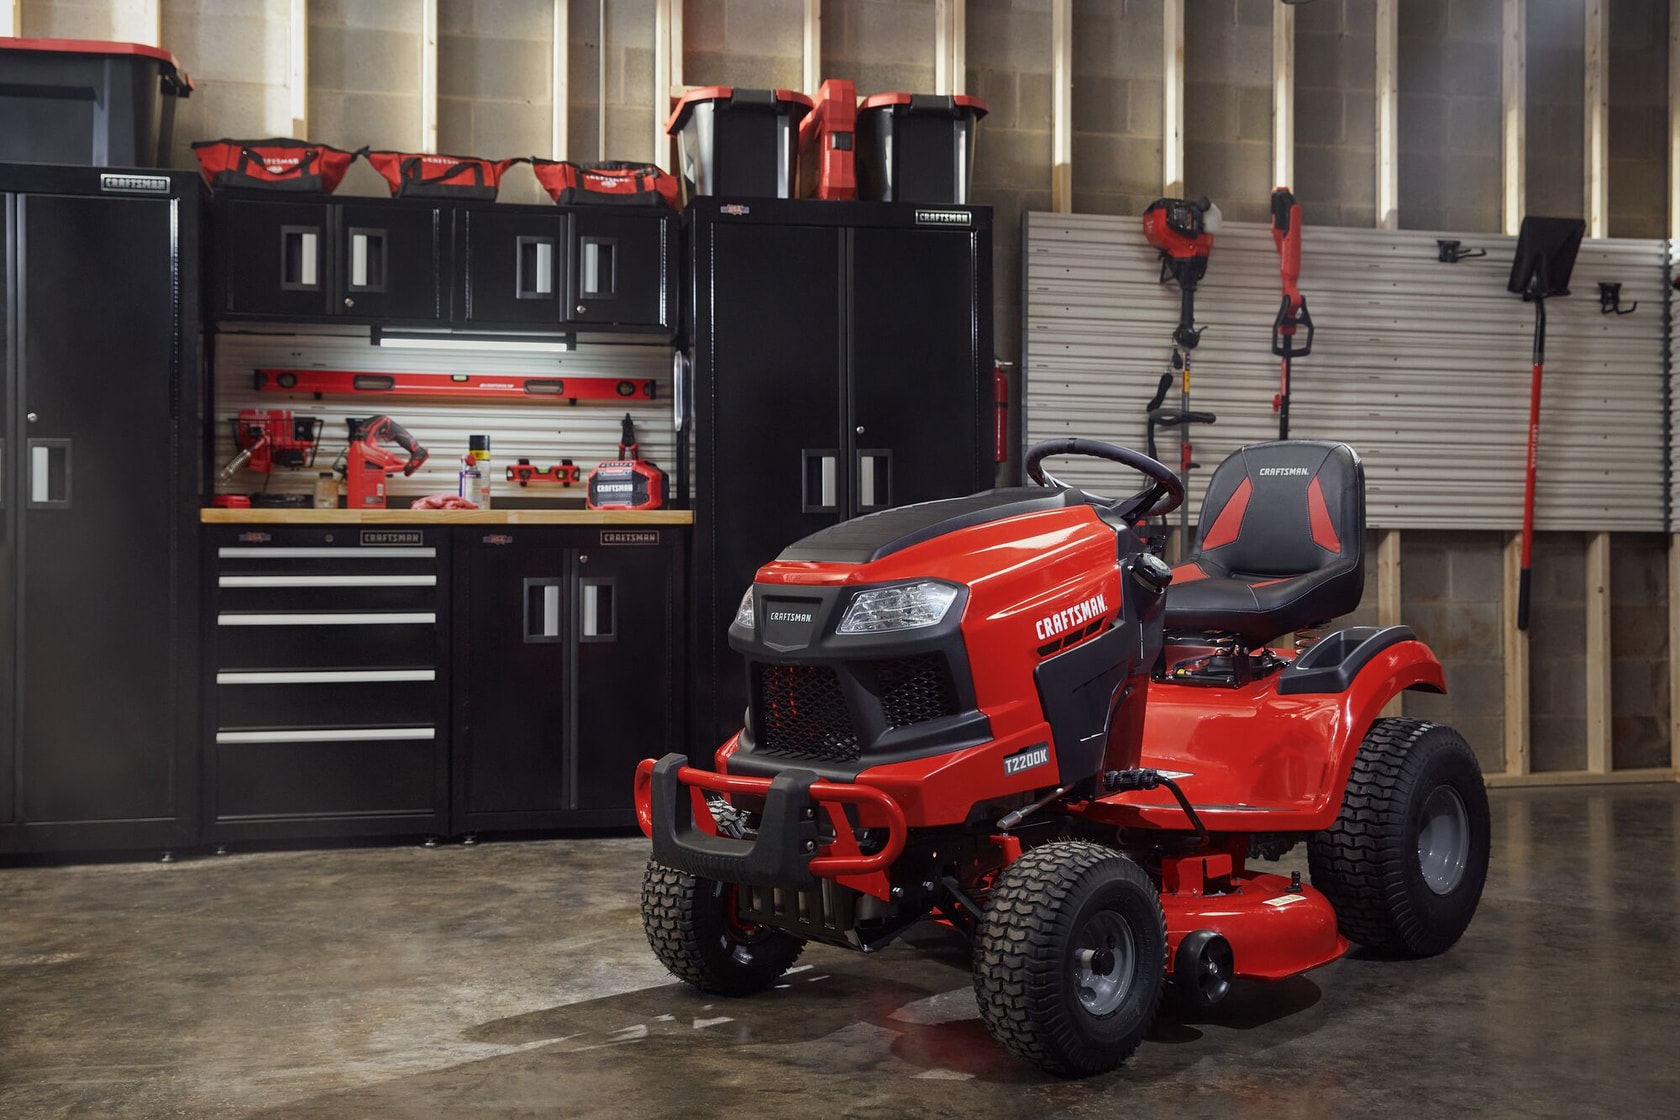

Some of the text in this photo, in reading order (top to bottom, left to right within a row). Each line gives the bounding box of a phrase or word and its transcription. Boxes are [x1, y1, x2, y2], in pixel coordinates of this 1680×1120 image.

[105, 178, 166, 190] CRAFTSMAN
[919, 212, 968, 223] CRAFTSMAN
[597, 484, 633, 493] CRAFTSMAN
[364, 533, 419, 542] CRAFTSMAN
[604, 533, 656, 542] CRAFTSMAN
[1005, 749, 1048, 773] T2200K
